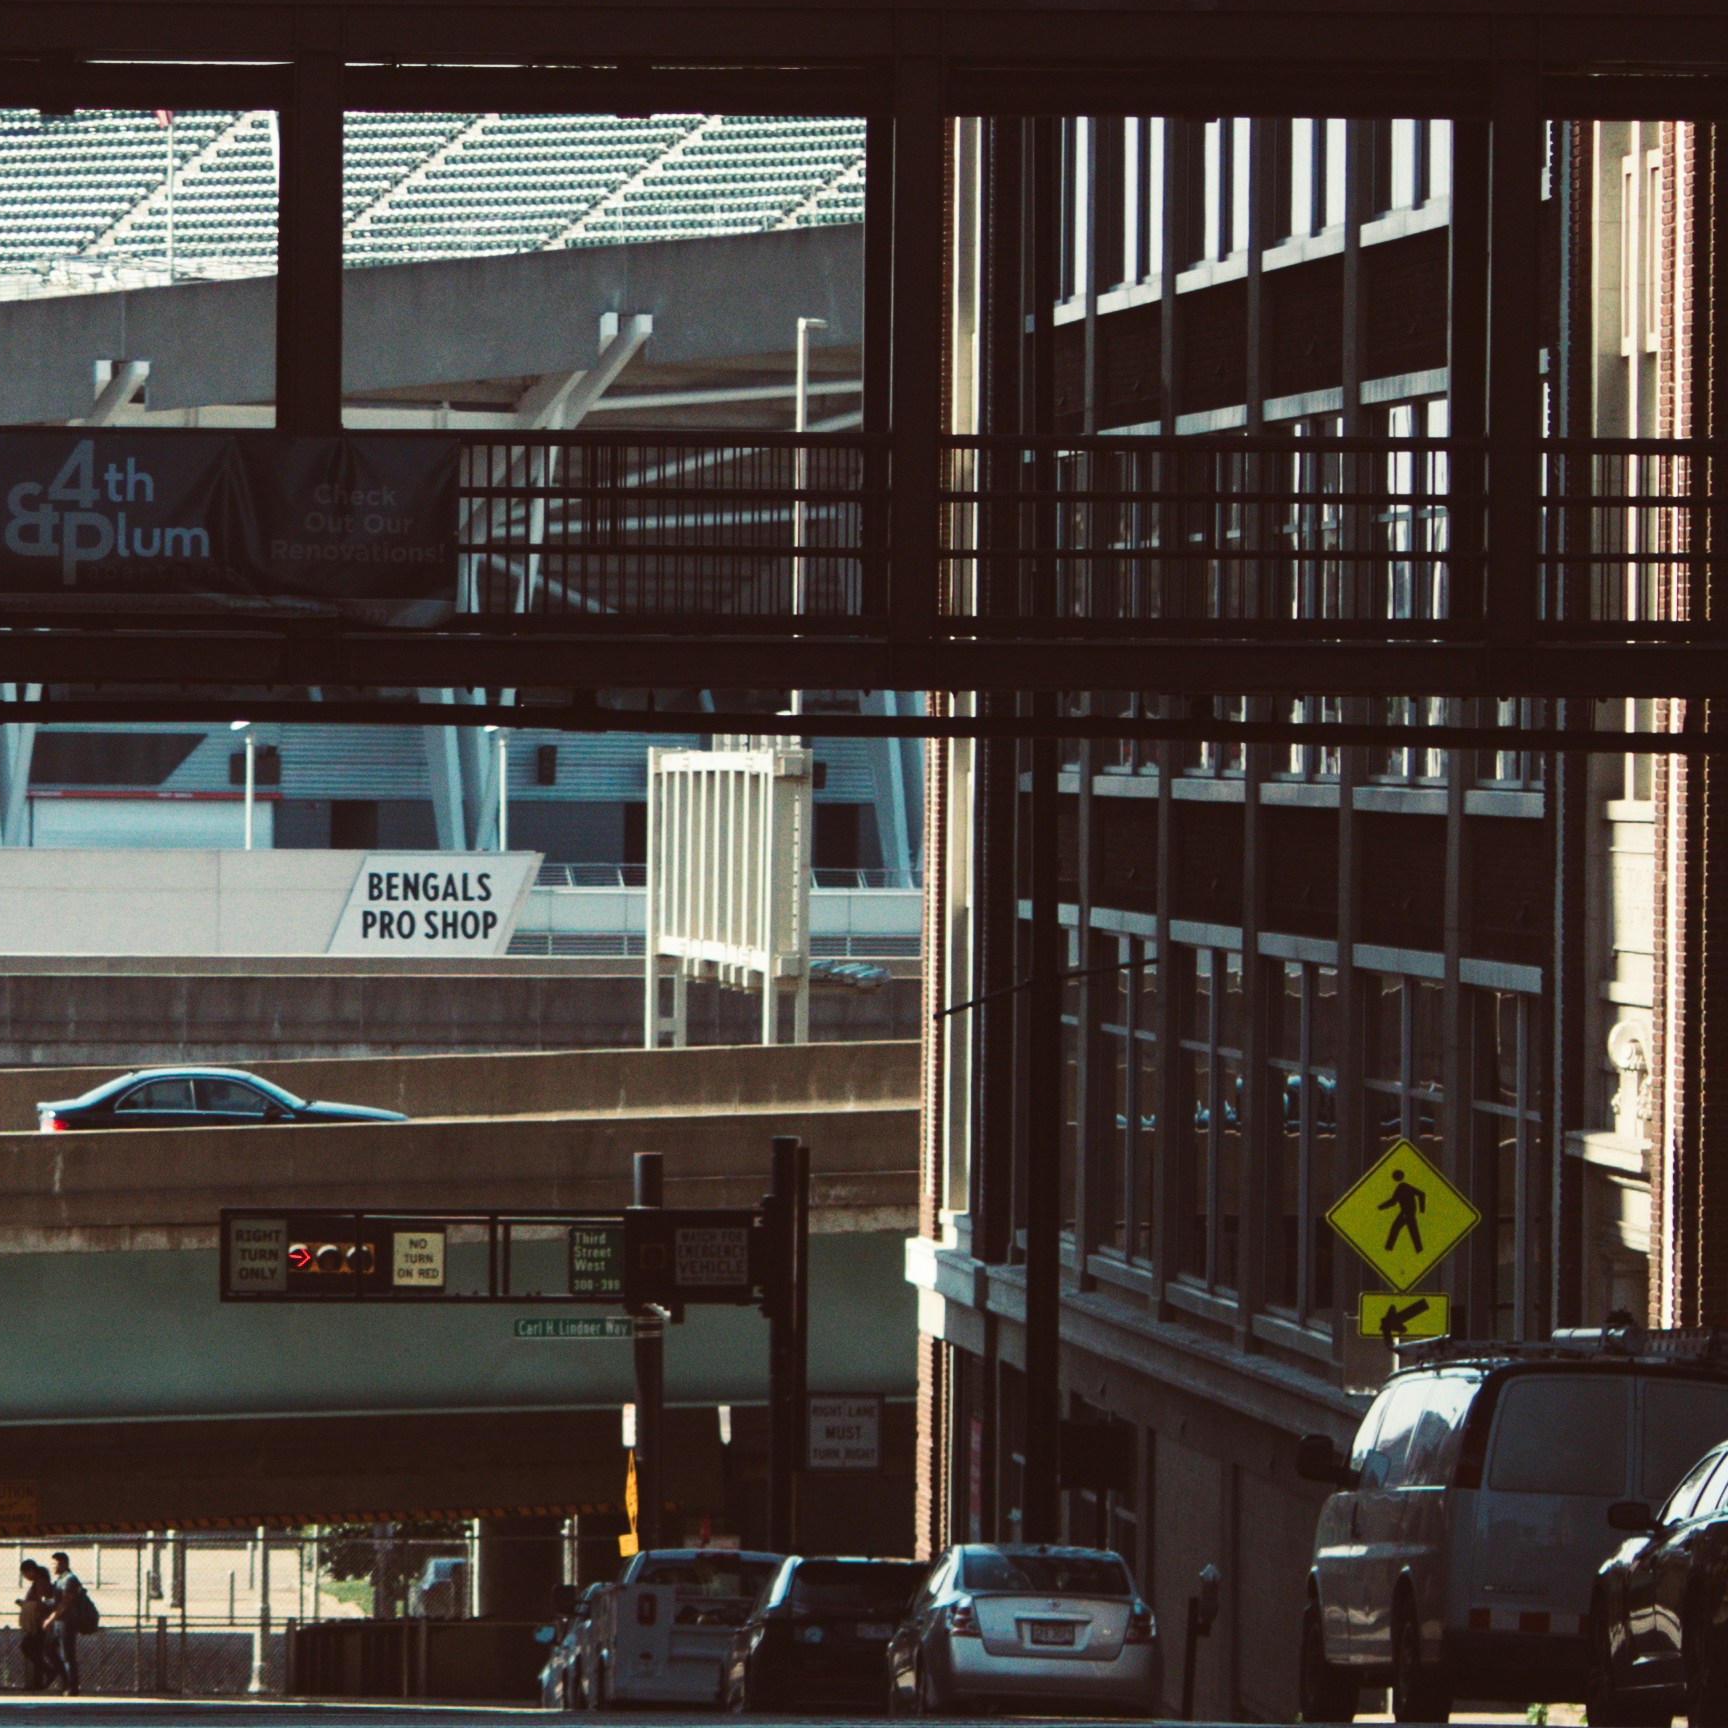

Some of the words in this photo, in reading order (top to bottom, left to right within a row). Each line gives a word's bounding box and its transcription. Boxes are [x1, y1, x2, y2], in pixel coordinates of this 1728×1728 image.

[48, 439, 154, 508] 4th
[314, 483, 397, 507] Check
[305, 511, 355, 534] Out
[363, 512, 414, 534] Our
[271, 538, 446, 563] Renovations!
[368, 872, 492, 902] BENGALS
[362, 910, 416, 940] PRO
[425, 910, 498, 940] SHOP
[235, 1229, 282, 1242] RIGHT
[574, 1232, 607, 1245] Third
[409, 1238, 428, 1249] NO
[240, 1248, 279, 1261] TURN
[403, 1253, 434, 1264] TURN
[574, 1246, 612, 1258] Street
[574, 1259, 606, 1271] West
[678, 1260, 745, 1275] VEHICLE
[239, 1267, 278, 1281] ONLY
[397, 1268, 414, 1279] ON
[419, 1268, 441, 1279] RED
[518, 1320, 543, 1335] Carl
[559, 1320, 601, 1335] Lindner
[606, 1320, 628, 1337] Way
[812, 1405, 843, 1417] RIGHT
[848, 1405, 876, 1418] LANE
[825, 1425, 862, 1440] MUST
[812, 1447, 840, 1460] TURN
